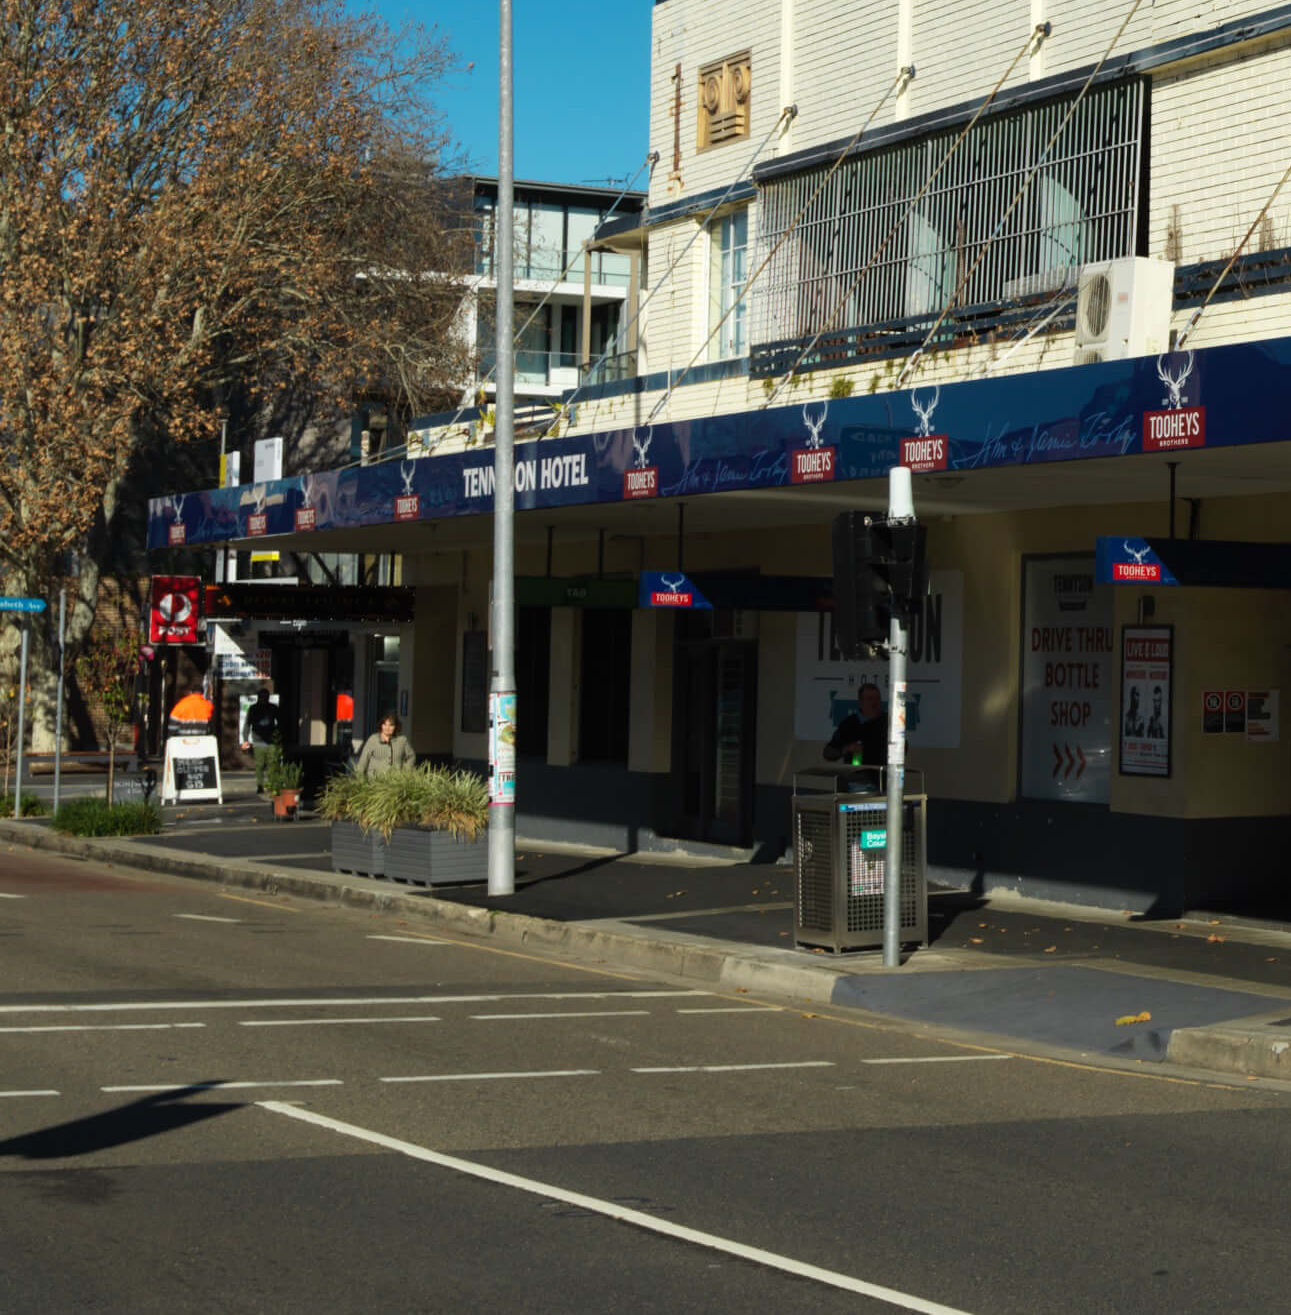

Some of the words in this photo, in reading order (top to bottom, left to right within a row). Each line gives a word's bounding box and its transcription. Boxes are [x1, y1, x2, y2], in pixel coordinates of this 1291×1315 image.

[1149, 411, 1201, 440] TOOHEYS
[904, 438, 944, 462] TOOHEYS
[1159, 437, 1189, 447] BROTHERS
[796, 452, 832, 473] TOOHEYS
[463, 458, 536, 498] TENNON
[541, 453, 589, 489] HOTEL
[627, 470, 656, 490] TOOHEYS
[1117, 565, 1157, 578] TOOHEYS
[566, 587, 588, 598] TAB
[655, 592, 690, 604] TOOHEYS
[158, 624, 192, 637] POST
[1031, 627, 1073, 653] DRIVE
[1078, 627, 1114, 652] THRU
[1044, 662, 1100, 689] BOTTLE
[1050, 700, 1092, 728] SHOP
